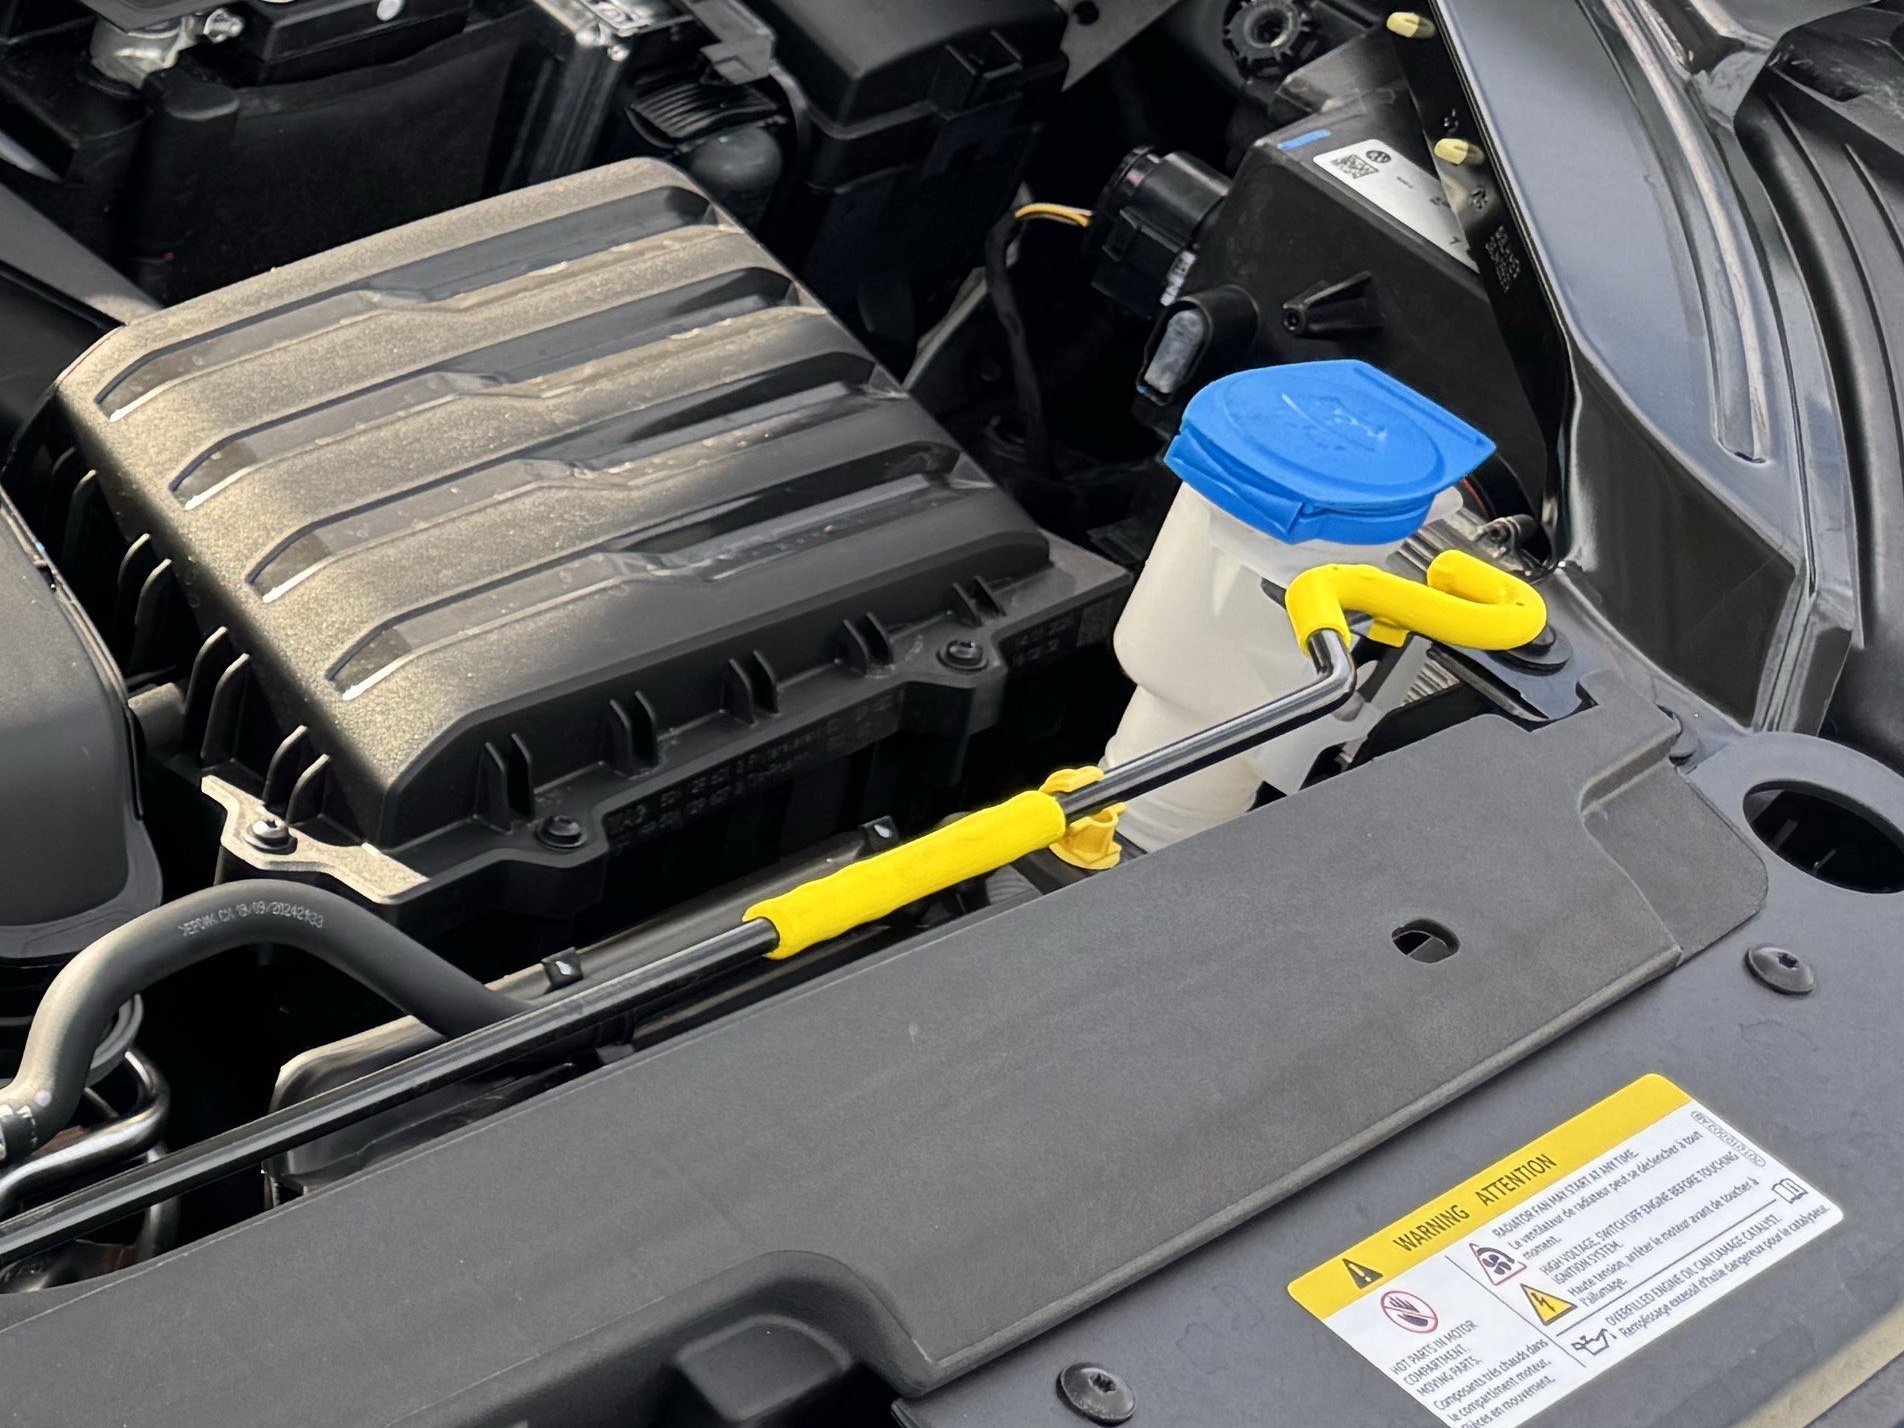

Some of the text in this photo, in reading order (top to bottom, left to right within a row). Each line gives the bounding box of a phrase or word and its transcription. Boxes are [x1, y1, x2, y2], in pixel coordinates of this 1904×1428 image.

[1392, 1152, 1558, 1253] WARNING ATTENTION
[1490, 1209, 1536, 1238] RADIATOR
[1530, 1199, 1552, 1214] FAN
[1545, 1189, 1570, 1205] MAY
[1562, 1175, 1592, 1195] START
[1586, 1169, 1602, 1180] AT
[1596, 1159, 1619, 1174] ANY
[1538, 1257, 1566, 1275] HIGH
[1593, 1217, 1630, 1241] SWITCH
[1622, 1208, 1645, 1223] OFF
[1638, 1191, 1673, 1214] ENGINE
[1666, 1173, 1702, 1197] BEFORE
[1695, 1150, 1741, 1179] TOUCHING
[1550, 1257, 1592, 1285] IGNITION
[1603, 1212, 1783, 1327] OVERFILLED ENGINE OIL CAN DAMAGE CATALYST.
[1388, 1318, 1478, 1375] HOT PARTS IN MOTOR
[1415, 1370, 1455, 1397] MOVING
